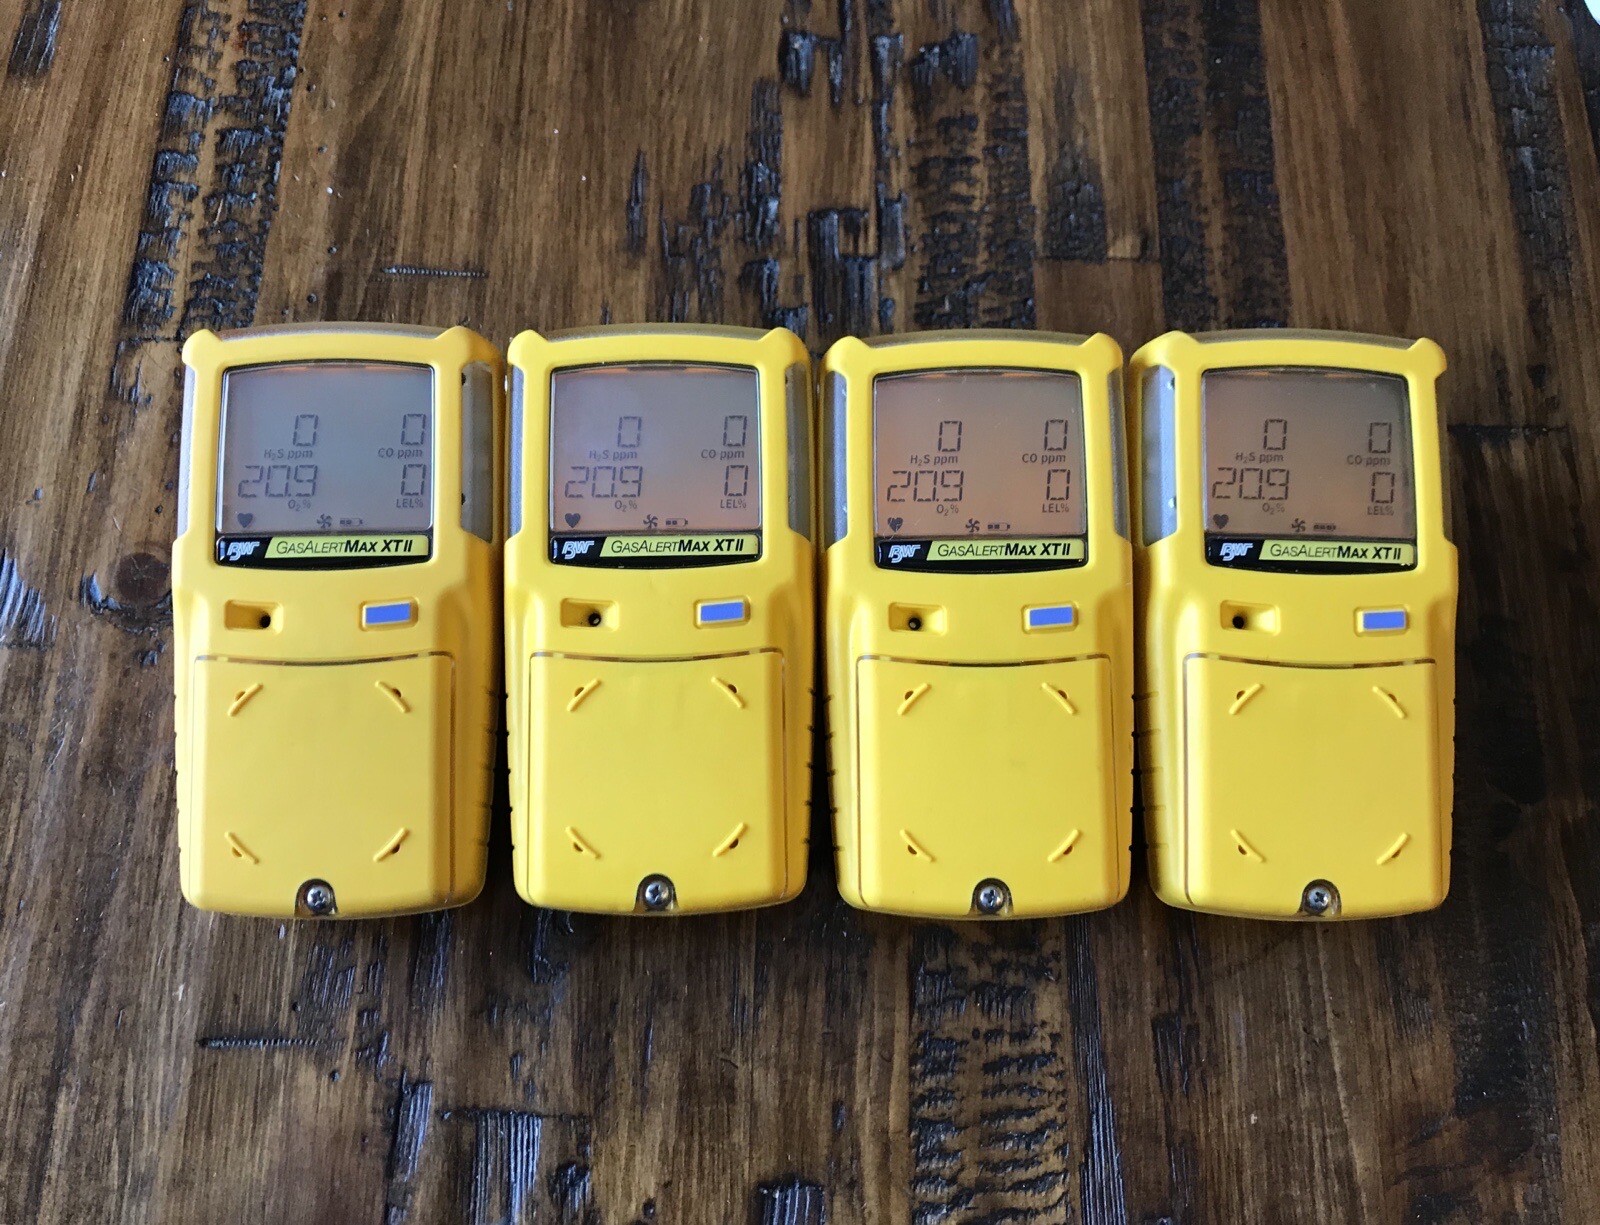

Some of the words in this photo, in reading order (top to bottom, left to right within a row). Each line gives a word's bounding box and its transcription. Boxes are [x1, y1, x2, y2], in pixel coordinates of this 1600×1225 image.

[292, 414, 319, 447] 0
[400, 413, 427, 446] 0
[617, 416, 642, 448] 0
[722, 415, 747, 446] 0
[938, 421, 963, 452] 0
[1044, 419, 1068, 451] 0
[1263, 418, 1288, 450] 0
[1368, 422, 1392, 453] 0
[288, 450, 313, 461] ppm
[377, 448, 394, 458] CO
[398, 449, 423, 460] ppm
[612, 451, 638, 461] ppm
[701, 449, 716, 459] CO
[720, 450, 745, 461] ppm
[934, 455, 959, 466] ppm
[1022, 453, 1037, 463] CO
[1041, 454, 1066, 465] ppm
[1259, 454, 1284, 464] ppm
[1347, 455, 1362, 464] CO
[1366, 456, 1391, 466] ppm
[400, 464, 427, 496] 0
[724, 465, 749, 496] 0
[1046, 469, 1070, 500] 0
[1371, 472, 1395, 504] 0
